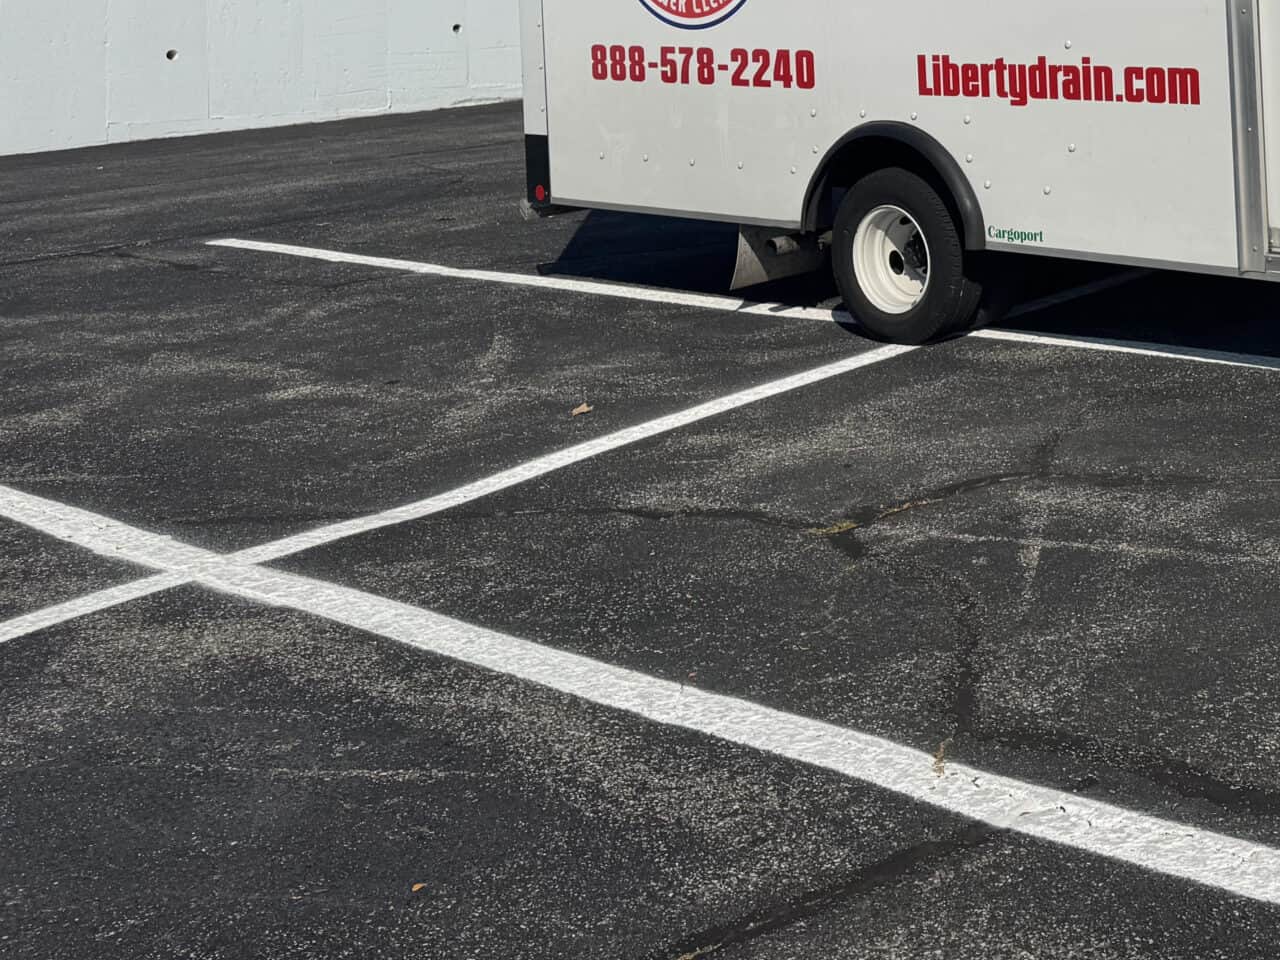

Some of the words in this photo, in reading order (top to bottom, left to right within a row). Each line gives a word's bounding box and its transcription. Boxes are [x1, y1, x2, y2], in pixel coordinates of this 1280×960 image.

[591, 44, 816, 90] 888-578-2240
[917, 54, 1201, 107] Libertydrain.com
[987, 224, 1044, 244] Cargoport
